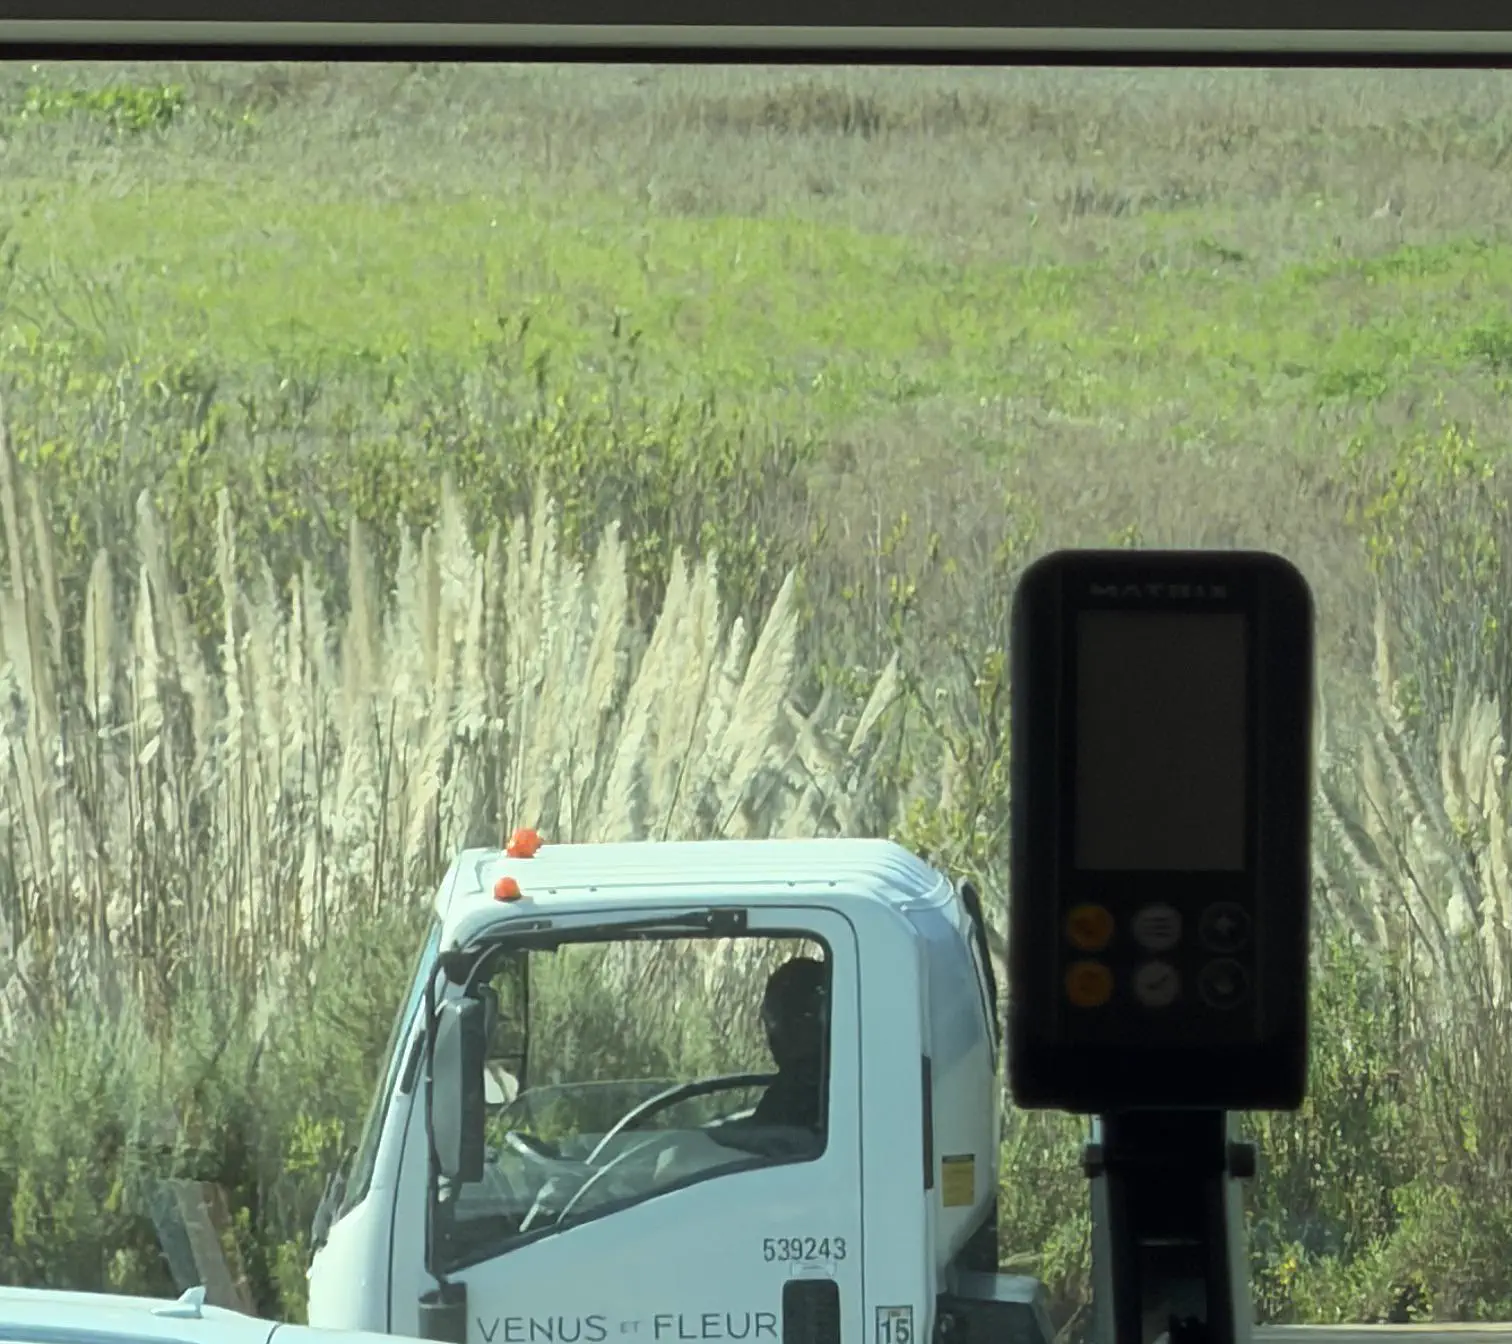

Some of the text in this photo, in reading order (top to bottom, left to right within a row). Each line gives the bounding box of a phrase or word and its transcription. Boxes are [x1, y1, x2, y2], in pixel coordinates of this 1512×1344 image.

[763, 1236, 847, 1262] 539243
[476, 1312, 778, 1343] VENUS ET FLEUR
[880, 1316, 910, 1344] 15
